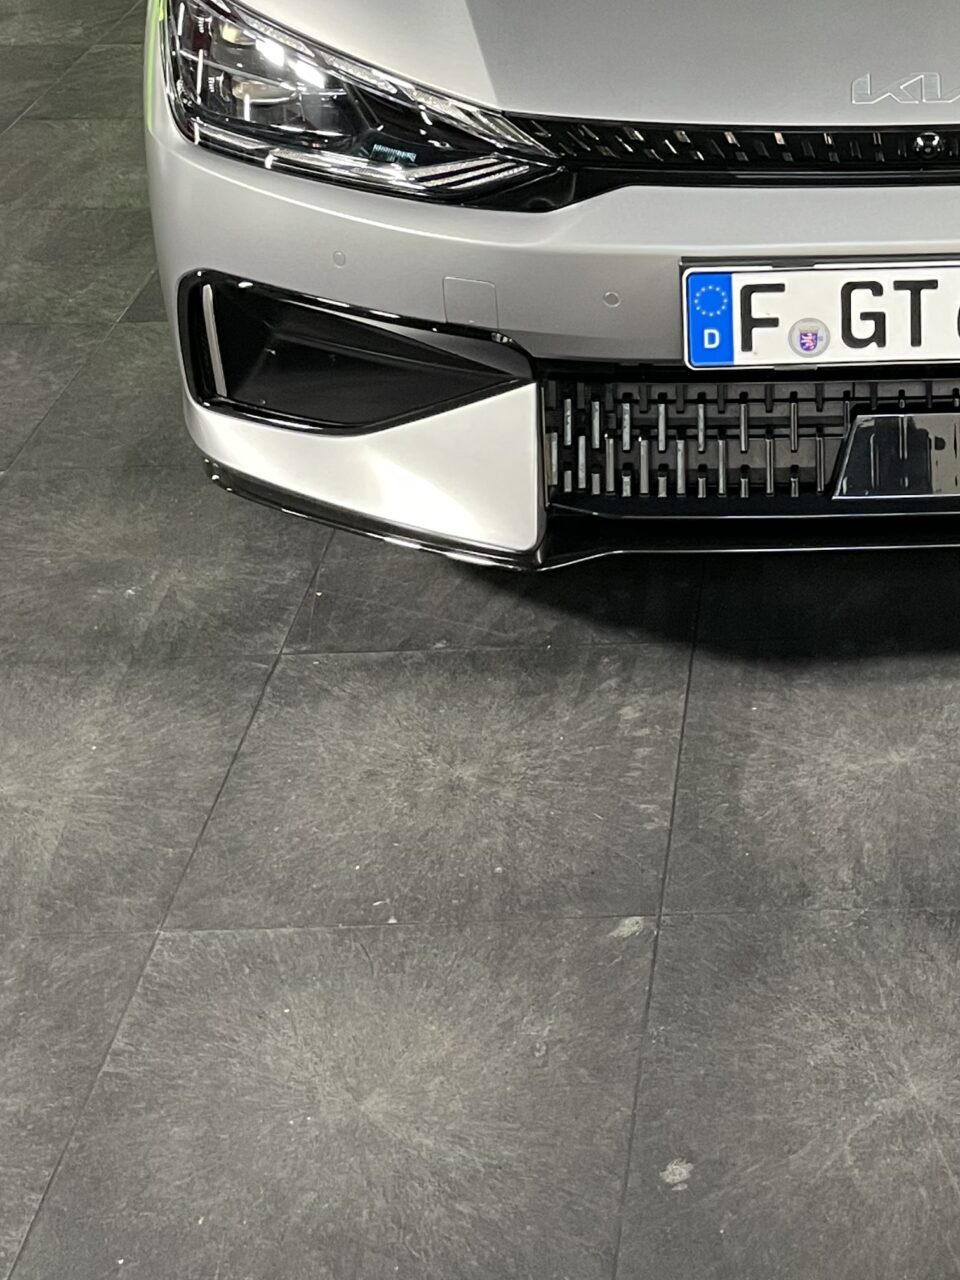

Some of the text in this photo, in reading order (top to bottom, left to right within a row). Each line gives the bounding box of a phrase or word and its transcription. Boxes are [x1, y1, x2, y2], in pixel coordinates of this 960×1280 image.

[703, 328, 721, 349] D
[740, 283, 786, 352] F
[840, 279, 939, 349] GT
